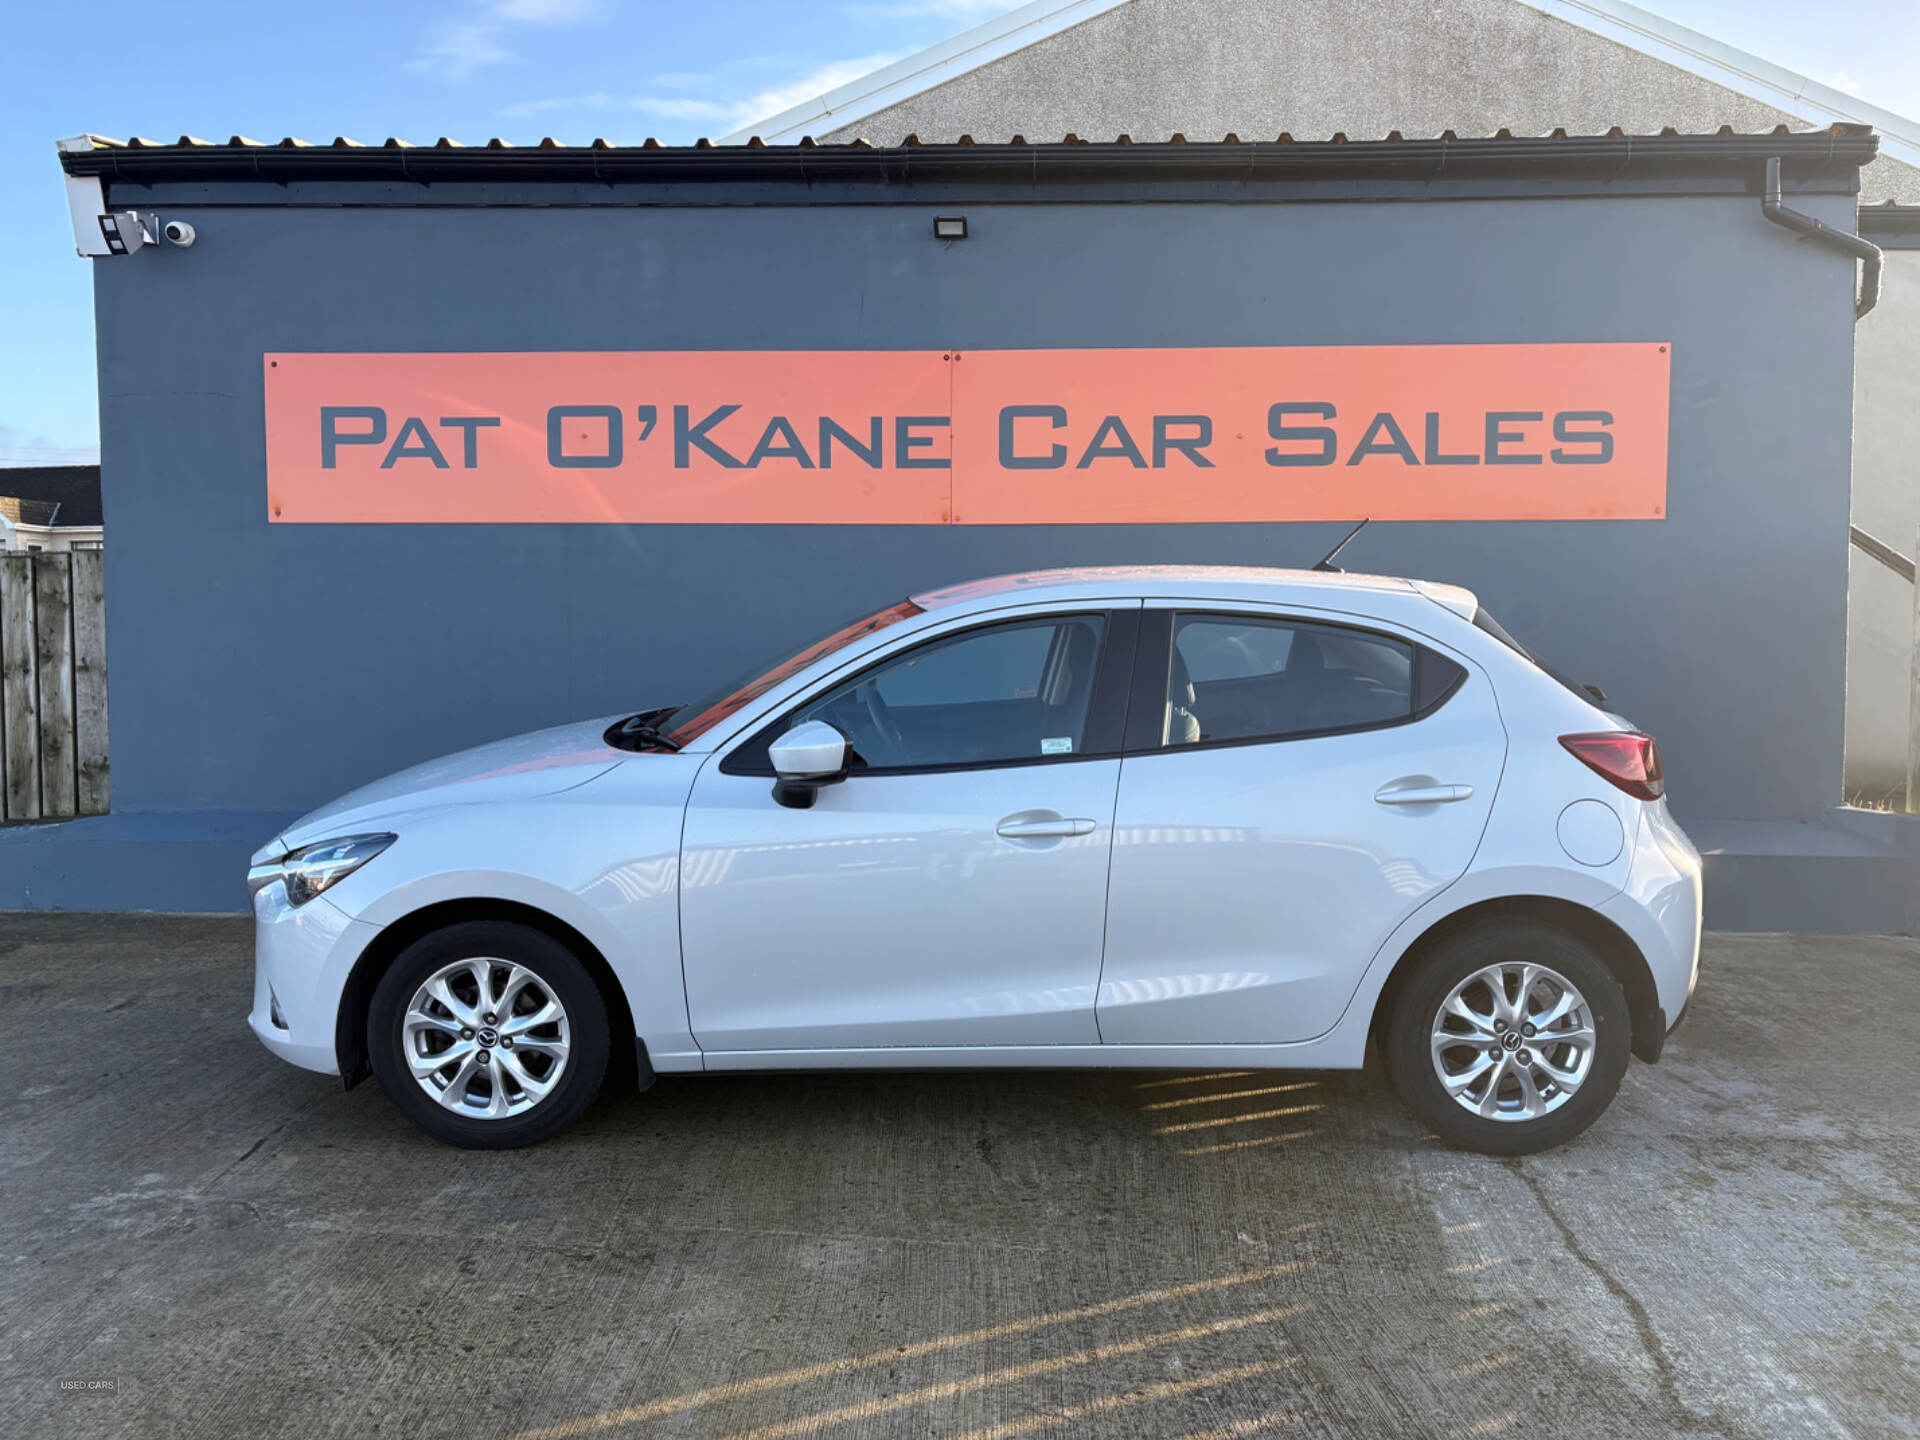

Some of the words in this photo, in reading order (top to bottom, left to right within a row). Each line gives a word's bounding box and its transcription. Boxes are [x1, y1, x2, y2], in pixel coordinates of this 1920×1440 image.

[320, 405, 501, 469] PAT
[547, 404, 951, 469] O'KANE
[998, 403, 1217, 469] CAR
[1264, 401, 1614, 467] SALES
